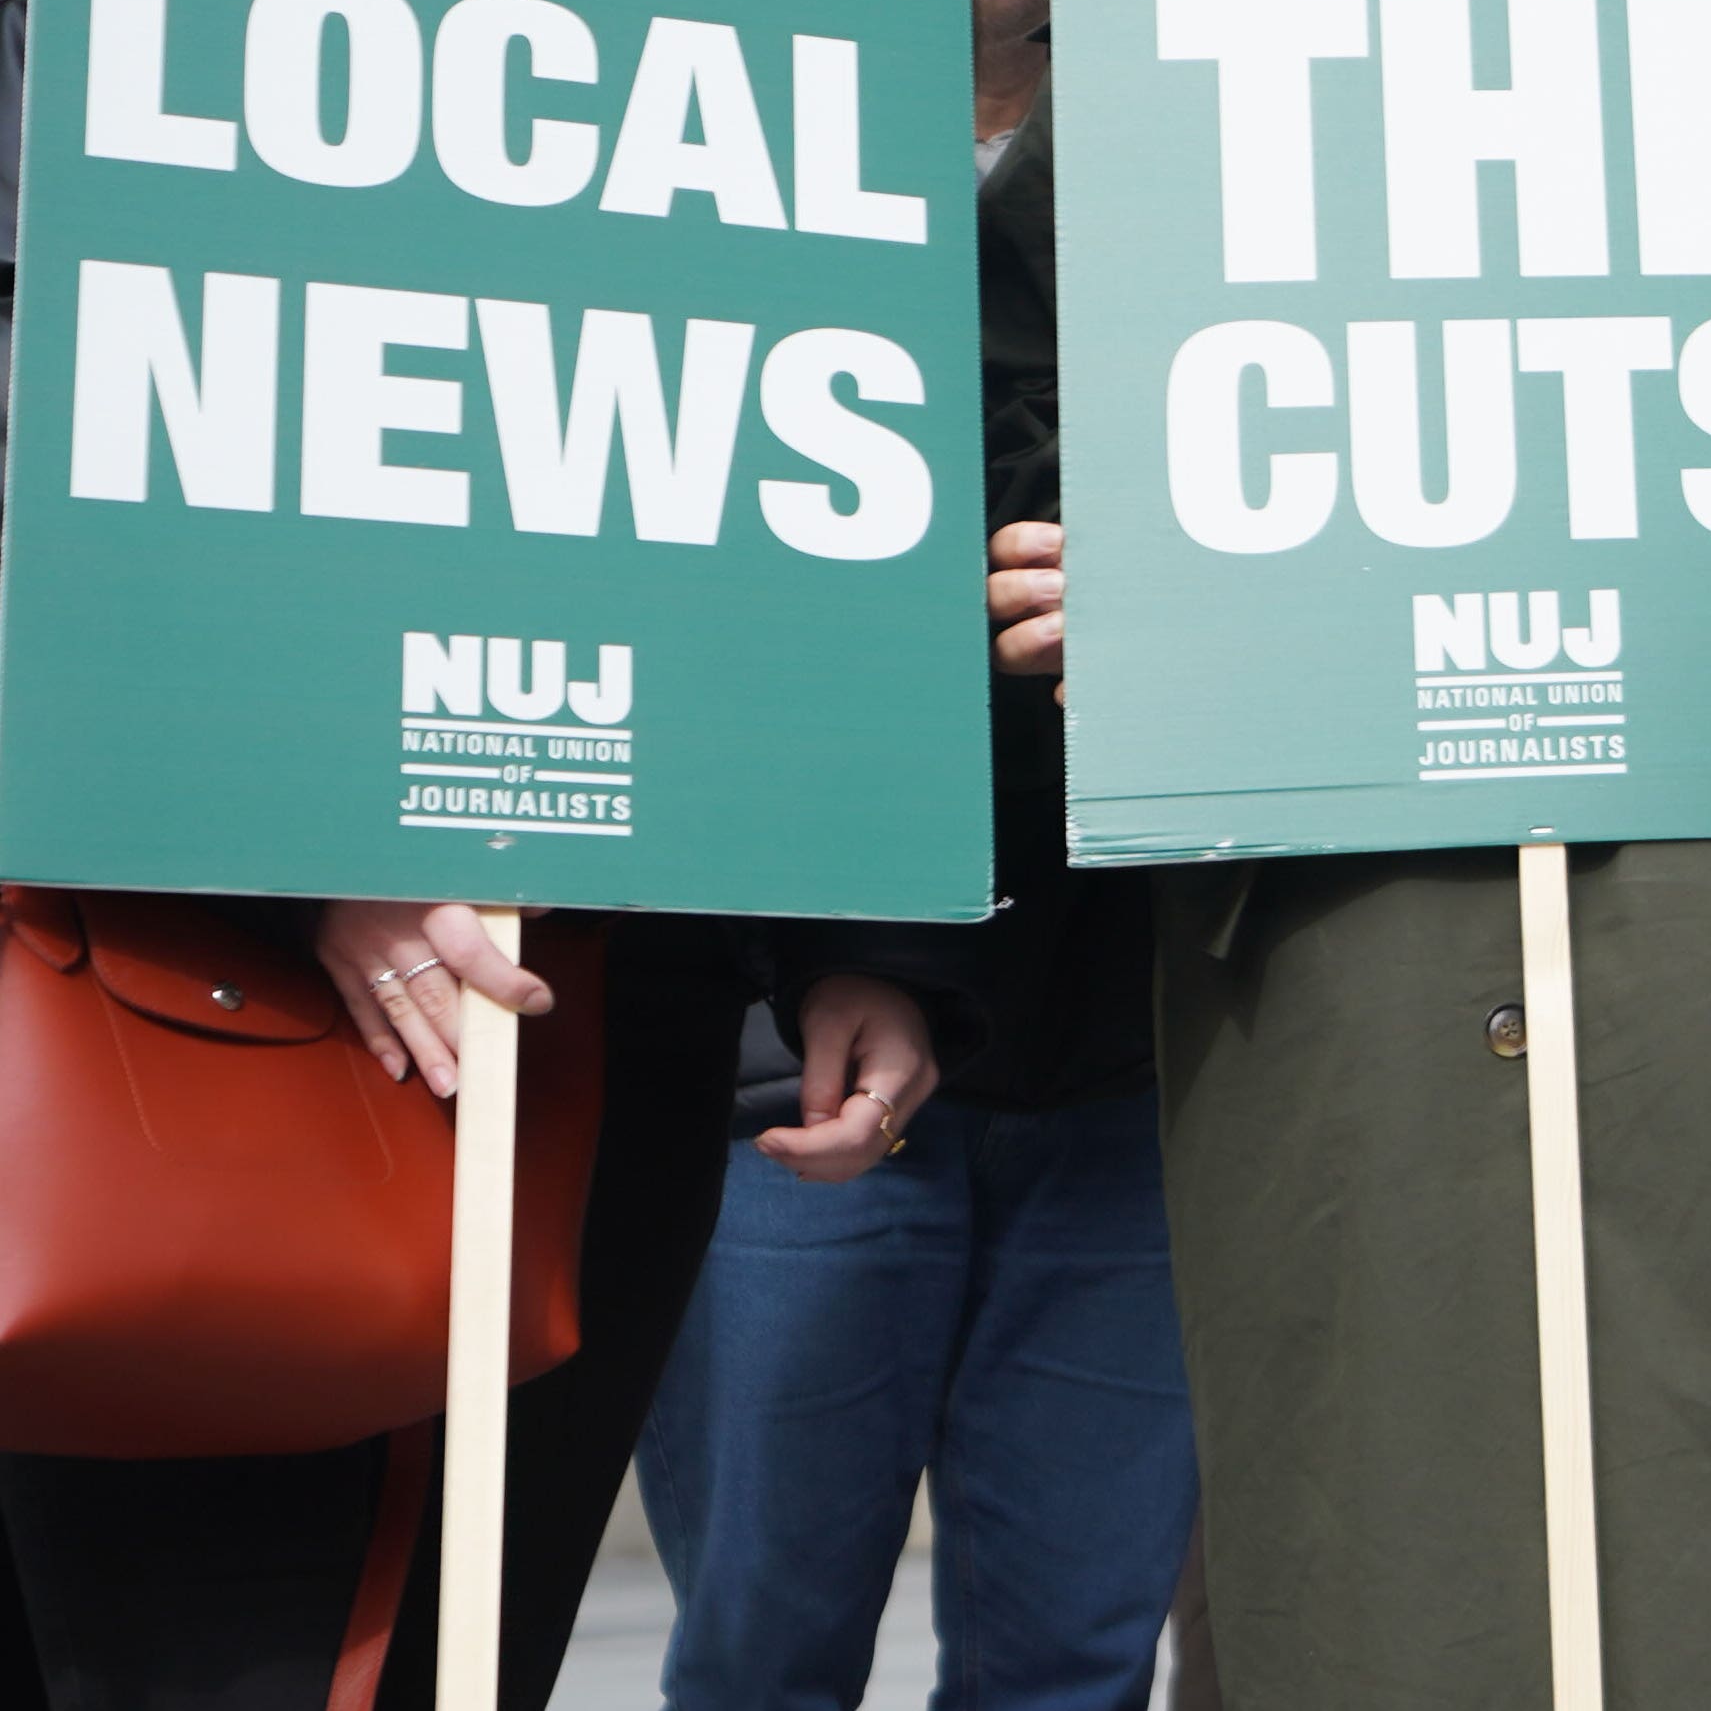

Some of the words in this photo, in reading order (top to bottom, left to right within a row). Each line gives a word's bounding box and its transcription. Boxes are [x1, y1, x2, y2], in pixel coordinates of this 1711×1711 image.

[70, 259, 934, 561] NEWS
[1412, 588, 1621, 672] NUJ
[402, 631, 633, 725] NUJ
[1417, 686, 1538, 709] NATIONAL
[1547, 684, 1623, 705] UNION
[1508, 714, 1535, 731] OF
[402, 730, 538, 758] NATIONAL
[547, 738, 632, 764] UNION
[1418, 735, 1626, 766] JOURNALISTS
[503, 764, 533, 784] OF
[400, 785, 632, 821] JOURNALISTS
